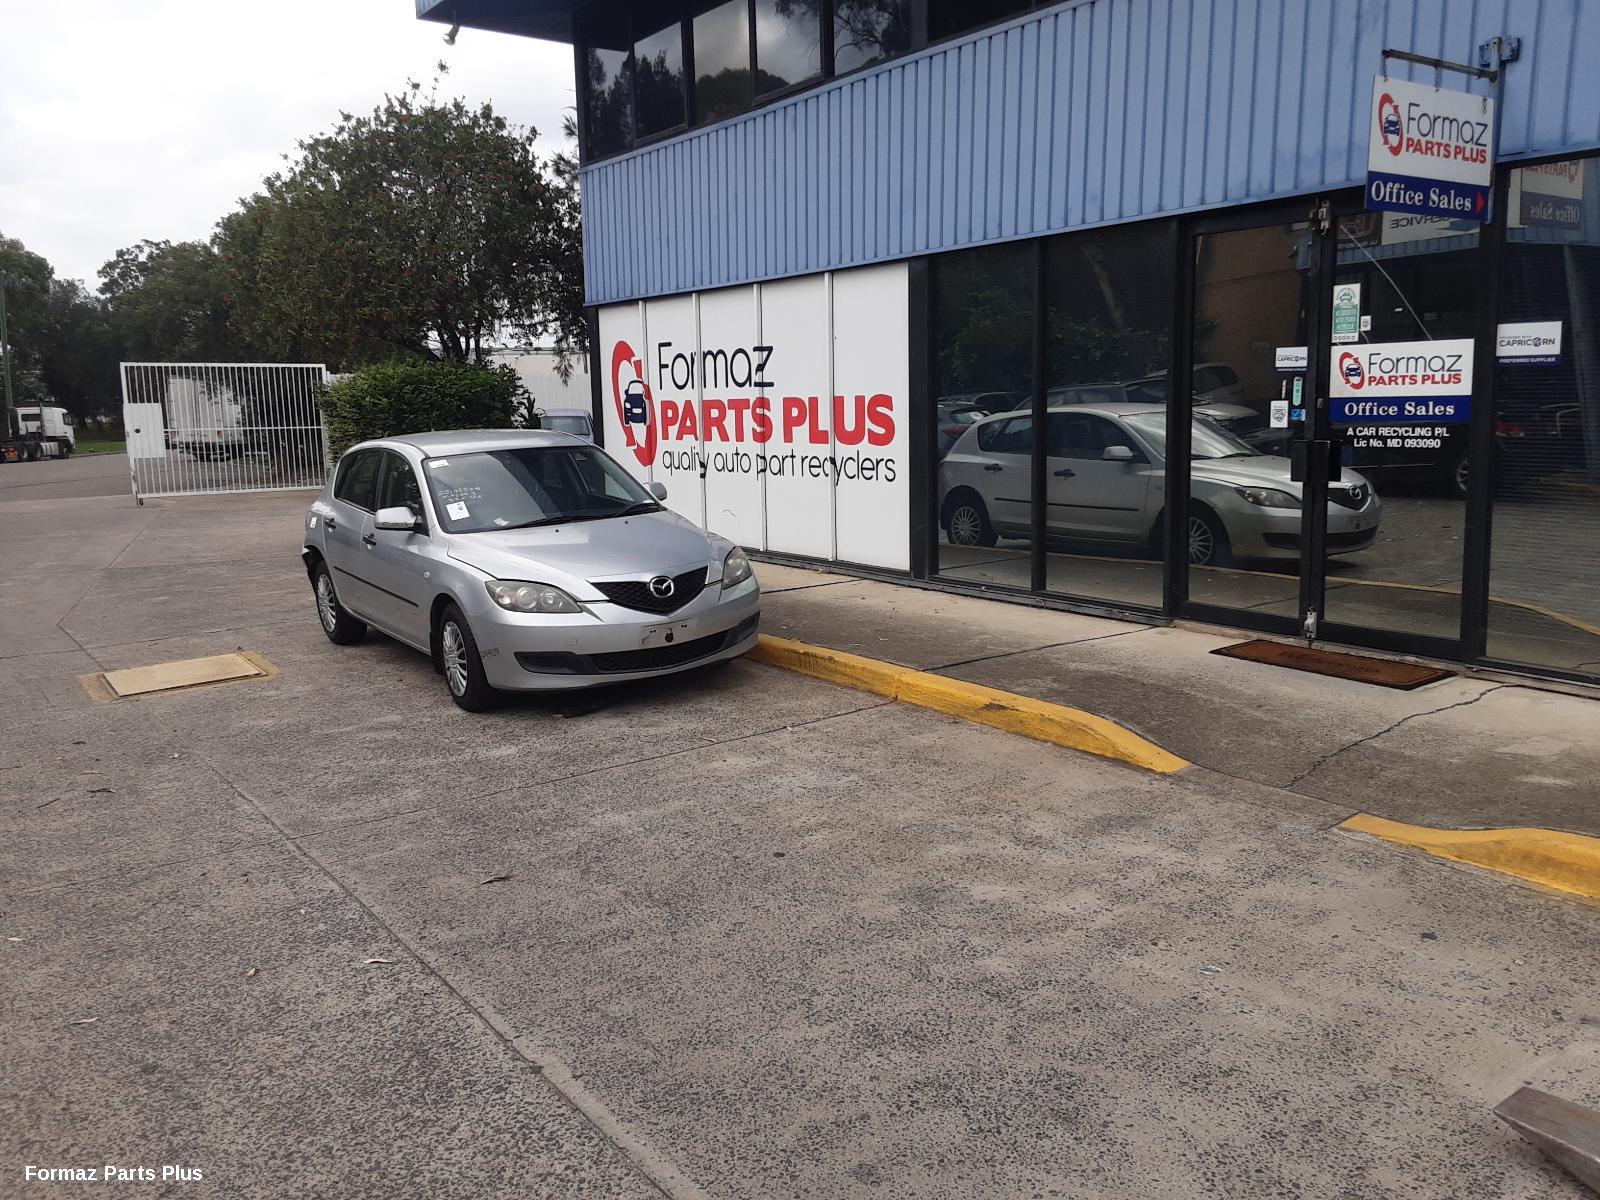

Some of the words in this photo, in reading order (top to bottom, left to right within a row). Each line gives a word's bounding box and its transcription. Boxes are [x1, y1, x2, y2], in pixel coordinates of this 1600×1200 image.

[1406, 102, 1488, 147] Formaz
[1405, 136, 1451, 159] PARTS
[1454, 144, 1487, 164] PLUS
[1371, 180, 1424, 206] Office
[1429, 187, 1472, 211] Sales
[657, 341, 775, 390] Formaz
[1368, 353, 1463, 374] Formaz
[1368, 374, 1418, 386] PARTS
[1421, 373, 1462, 385] PLUS
[660, 397, 774, 443] PARTS
[782, 393, 896, 446] PLUS
[1344, 402, 1398, 416] Office
[1404, 401, 1455, 415] Sales
[1346, 428, 1354, 436] A
[1356, 427, 1376, 436] CAR
[1378, 427, 1432, 436] RECYCLING
[1434, 427, 1450, 437] P/L
[1354, 439, 1367, 447] Lic
[1369, 439, 1384, 447] No.
[1386, 439, 1402, 447] MD
[1404, 438, 1441, 448] 093090
[662, 445, 710, 479] qualiy
[713, 446, 751, 474] auto
[756, 449, 797, 481] part
[801, 450, 897, 487] recyclers
